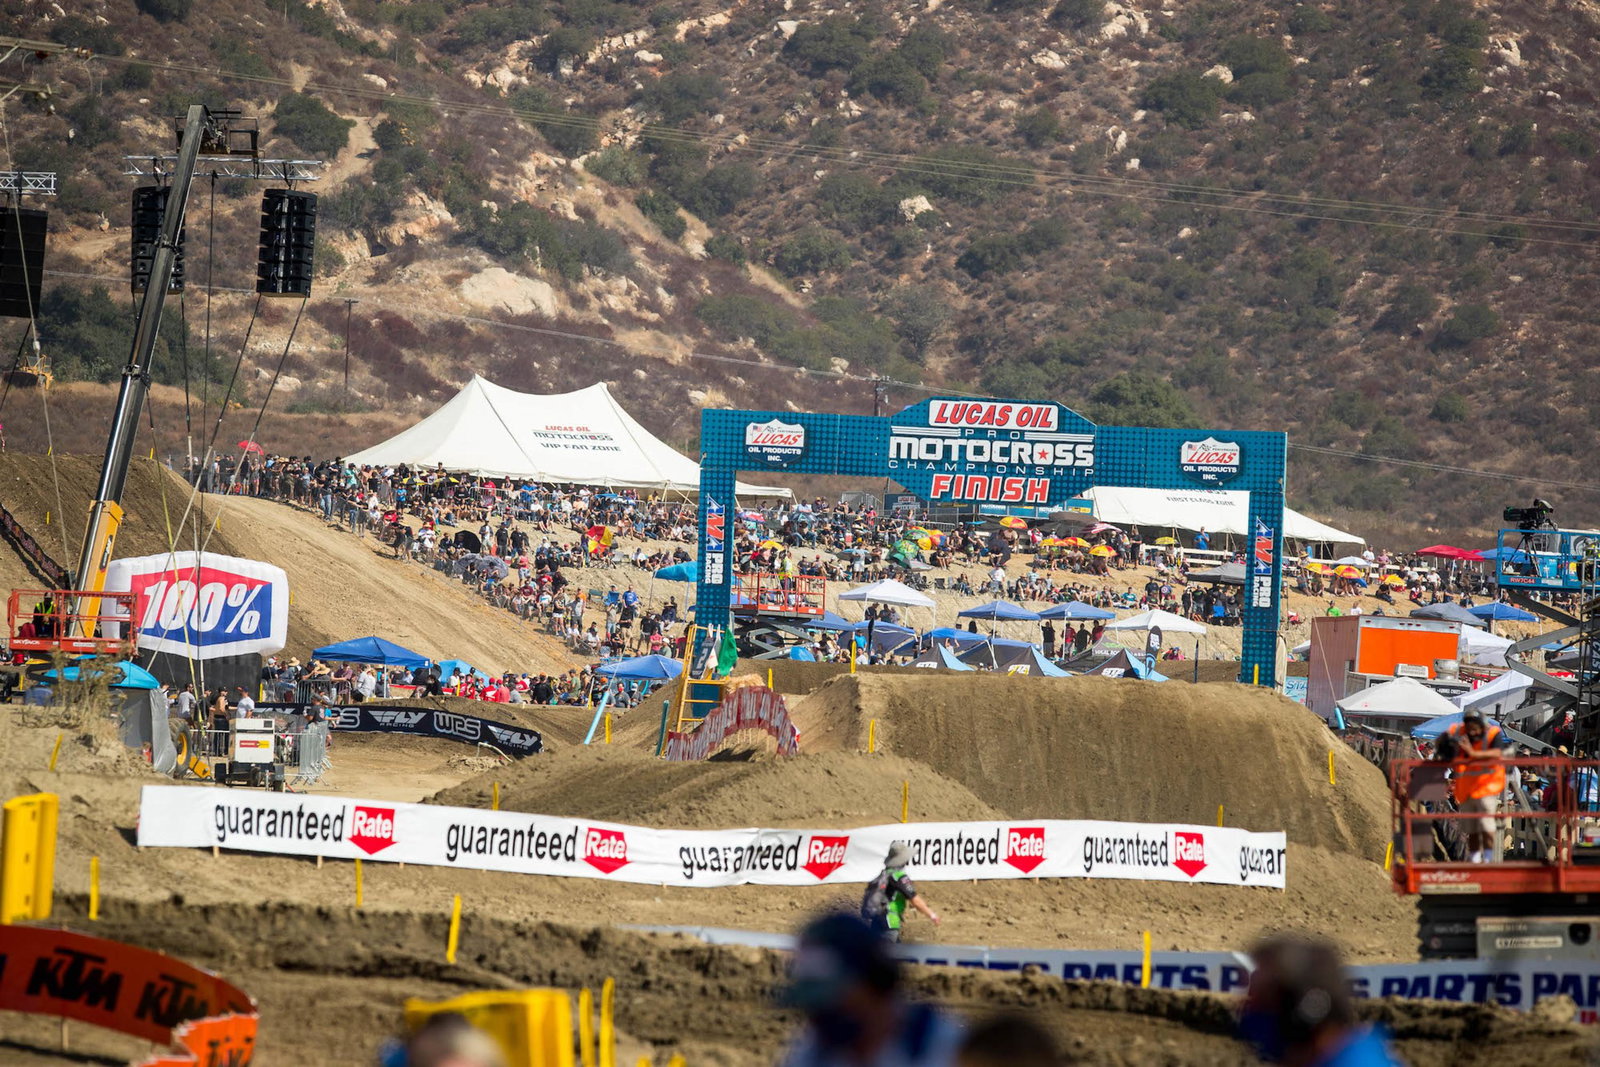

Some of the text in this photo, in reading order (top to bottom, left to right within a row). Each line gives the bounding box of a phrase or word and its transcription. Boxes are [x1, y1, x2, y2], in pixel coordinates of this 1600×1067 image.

[934, 402, 1054, 428] LUCAS OIL
[533, 431, 614, 441] MOTOCROSS
[752, 432, 802, 445] LUCAS
[965, 428, 1021, 440] PRO
[762, 446, 802, 455] PRODUCTS
[889, 436, 1095, 467] MOTOCROSS
[1187, 451, 1237, 464] LUCAS
[888, 460, 1095, 477] CHAMPIONSHIP
[930, 473, 1051, 504] FINISH
[705, 492, 725, 552] AMA
[1253, 515, 1274, 575] AMA
[711, 553, 724, 584] PRO
[1259, 576, 1272, 607] PRO
[138, 580, 263, 635] 100%
[367, 710, 427, 724] FLY
[433, 711, 481, 740] WPS
[487, 724, 539, 747] FLY
[215, 803, 346, 843] guaranteed
[354, 810, 393, 839] Rate
[446, 821, 579, 862] guaranteed
[587, 830, 626, 859] Rate
[679, 835, 802, 880] guaranteed
[809, 839, 845, 864] Rate
[893, 827, 1000, 866] aranteed
[1009, 832, 1044, 857] Rate
[1083, 831, 1169, 873] guaranteed
[1175, 836, 1204, 861] Rate
[26, 946, 124, 1012] KTM
[1381, 972, 1523, 1007] PARTS
